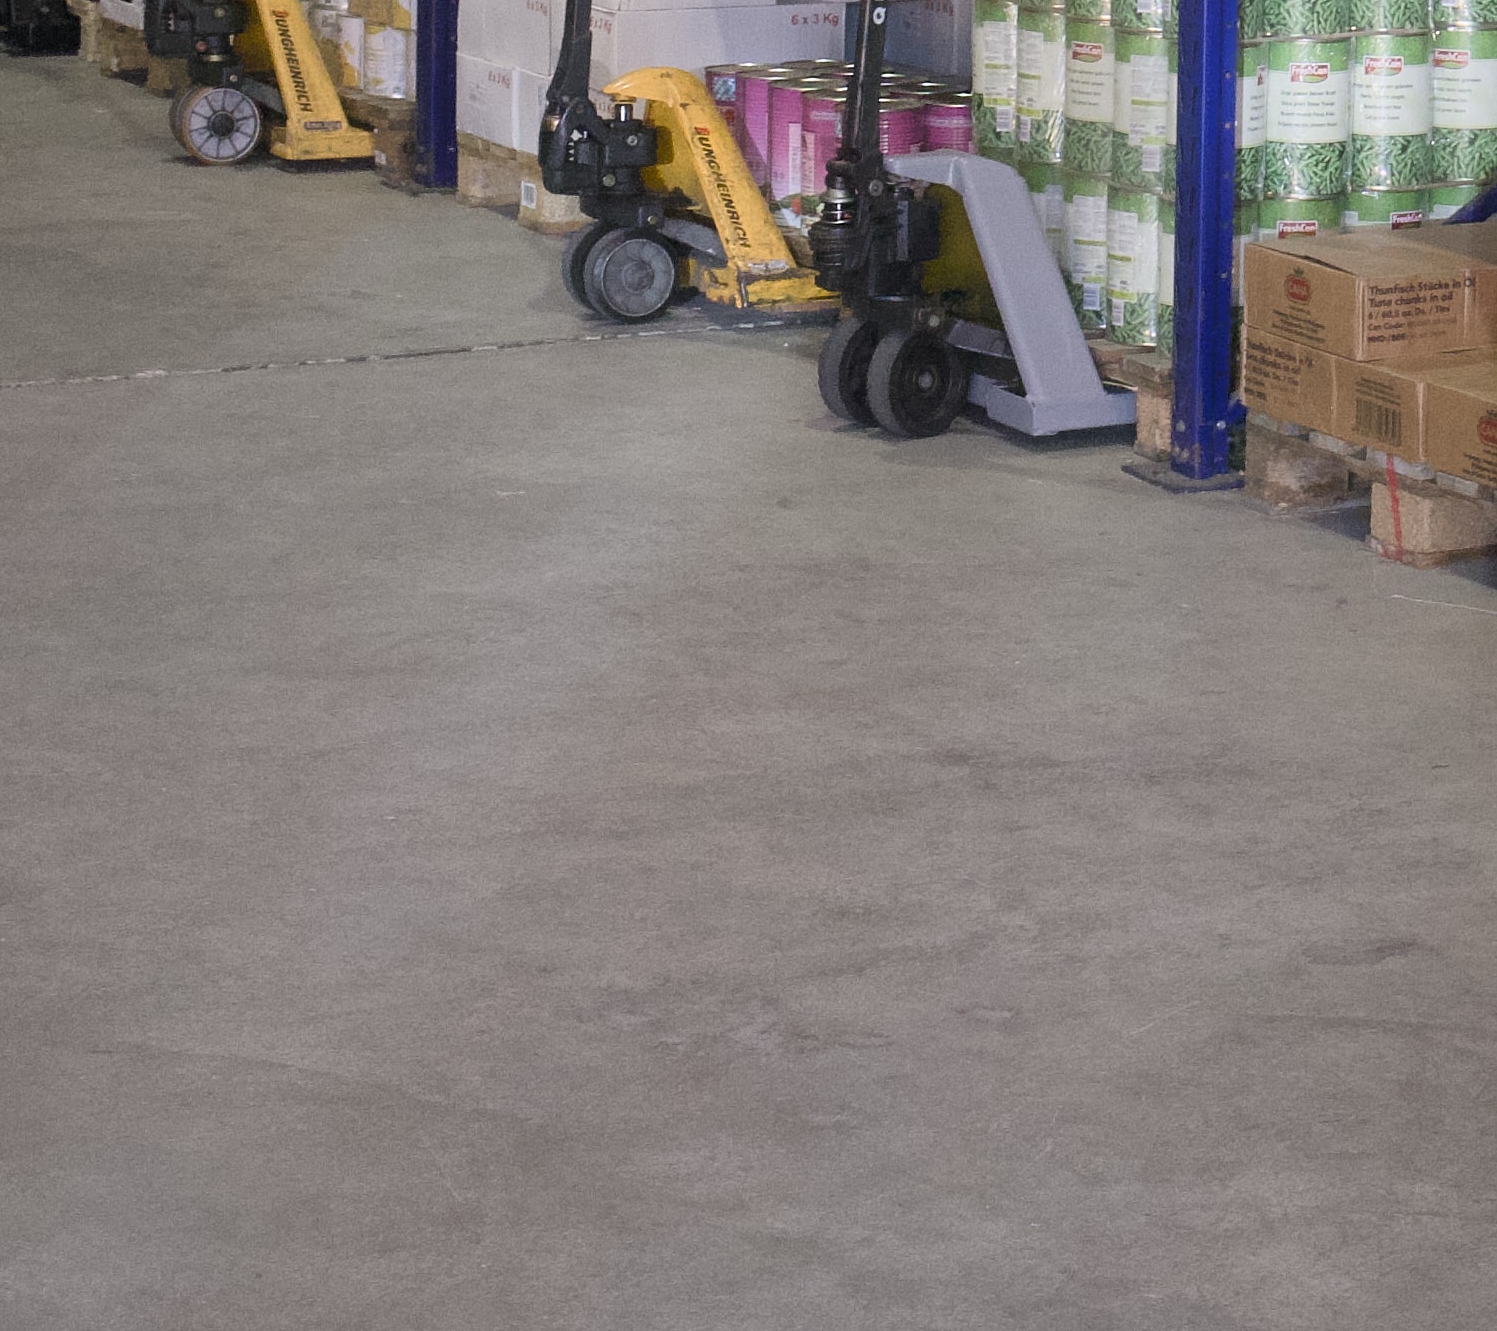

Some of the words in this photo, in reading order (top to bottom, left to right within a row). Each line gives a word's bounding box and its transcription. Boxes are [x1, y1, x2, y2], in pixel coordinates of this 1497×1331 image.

[271, 8, 313, 113] JUNGHEINRICH
[1290, 63, 1330, 81] FreshCan
[693, 124, 752, 249] JUNGHEINRICH
[1278, 221, 1317, 235] FreshCan
[1369, 281, 1415, 296] Thunfisch
[1417, 278, 1449, 292] Stücke
